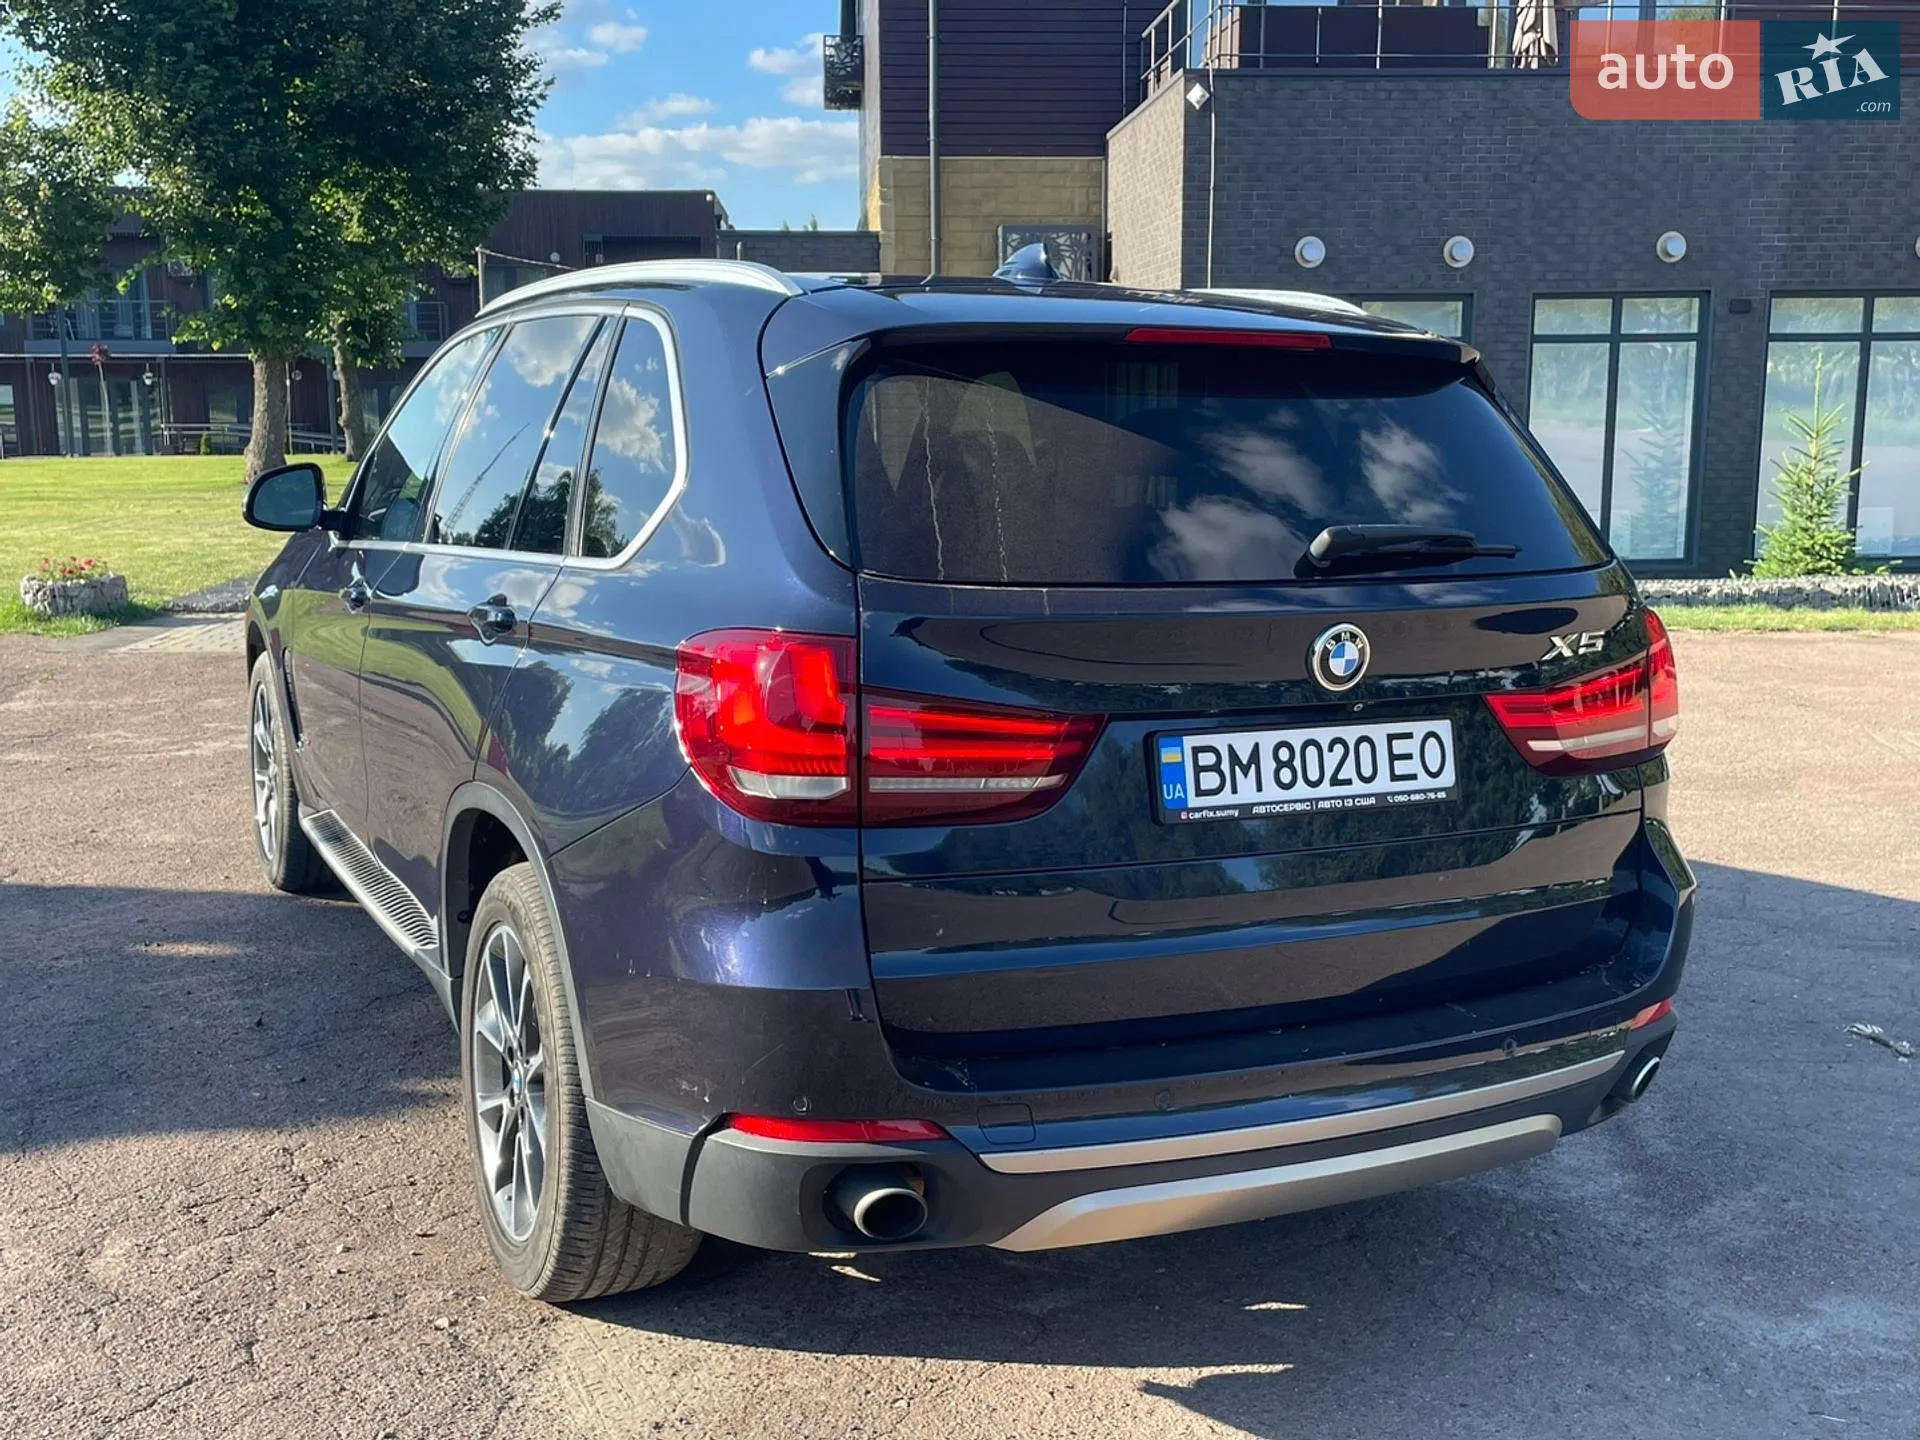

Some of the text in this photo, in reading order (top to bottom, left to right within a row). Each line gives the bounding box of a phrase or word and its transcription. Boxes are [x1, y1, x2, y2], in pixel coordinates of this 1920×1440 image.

[1325, 631, 1364, 651] BMW
[1541, 630, 1606, 661] X5
[1191, 730, 1447, 798] BM 8020 EO
[1163, 783, 1185, 800] UA
[1252, 801, 1312, 815] АВТОСЕРВІС
[1317, 798, 1343, 809] АВТО
[1354, 796, 1376, 806] США
